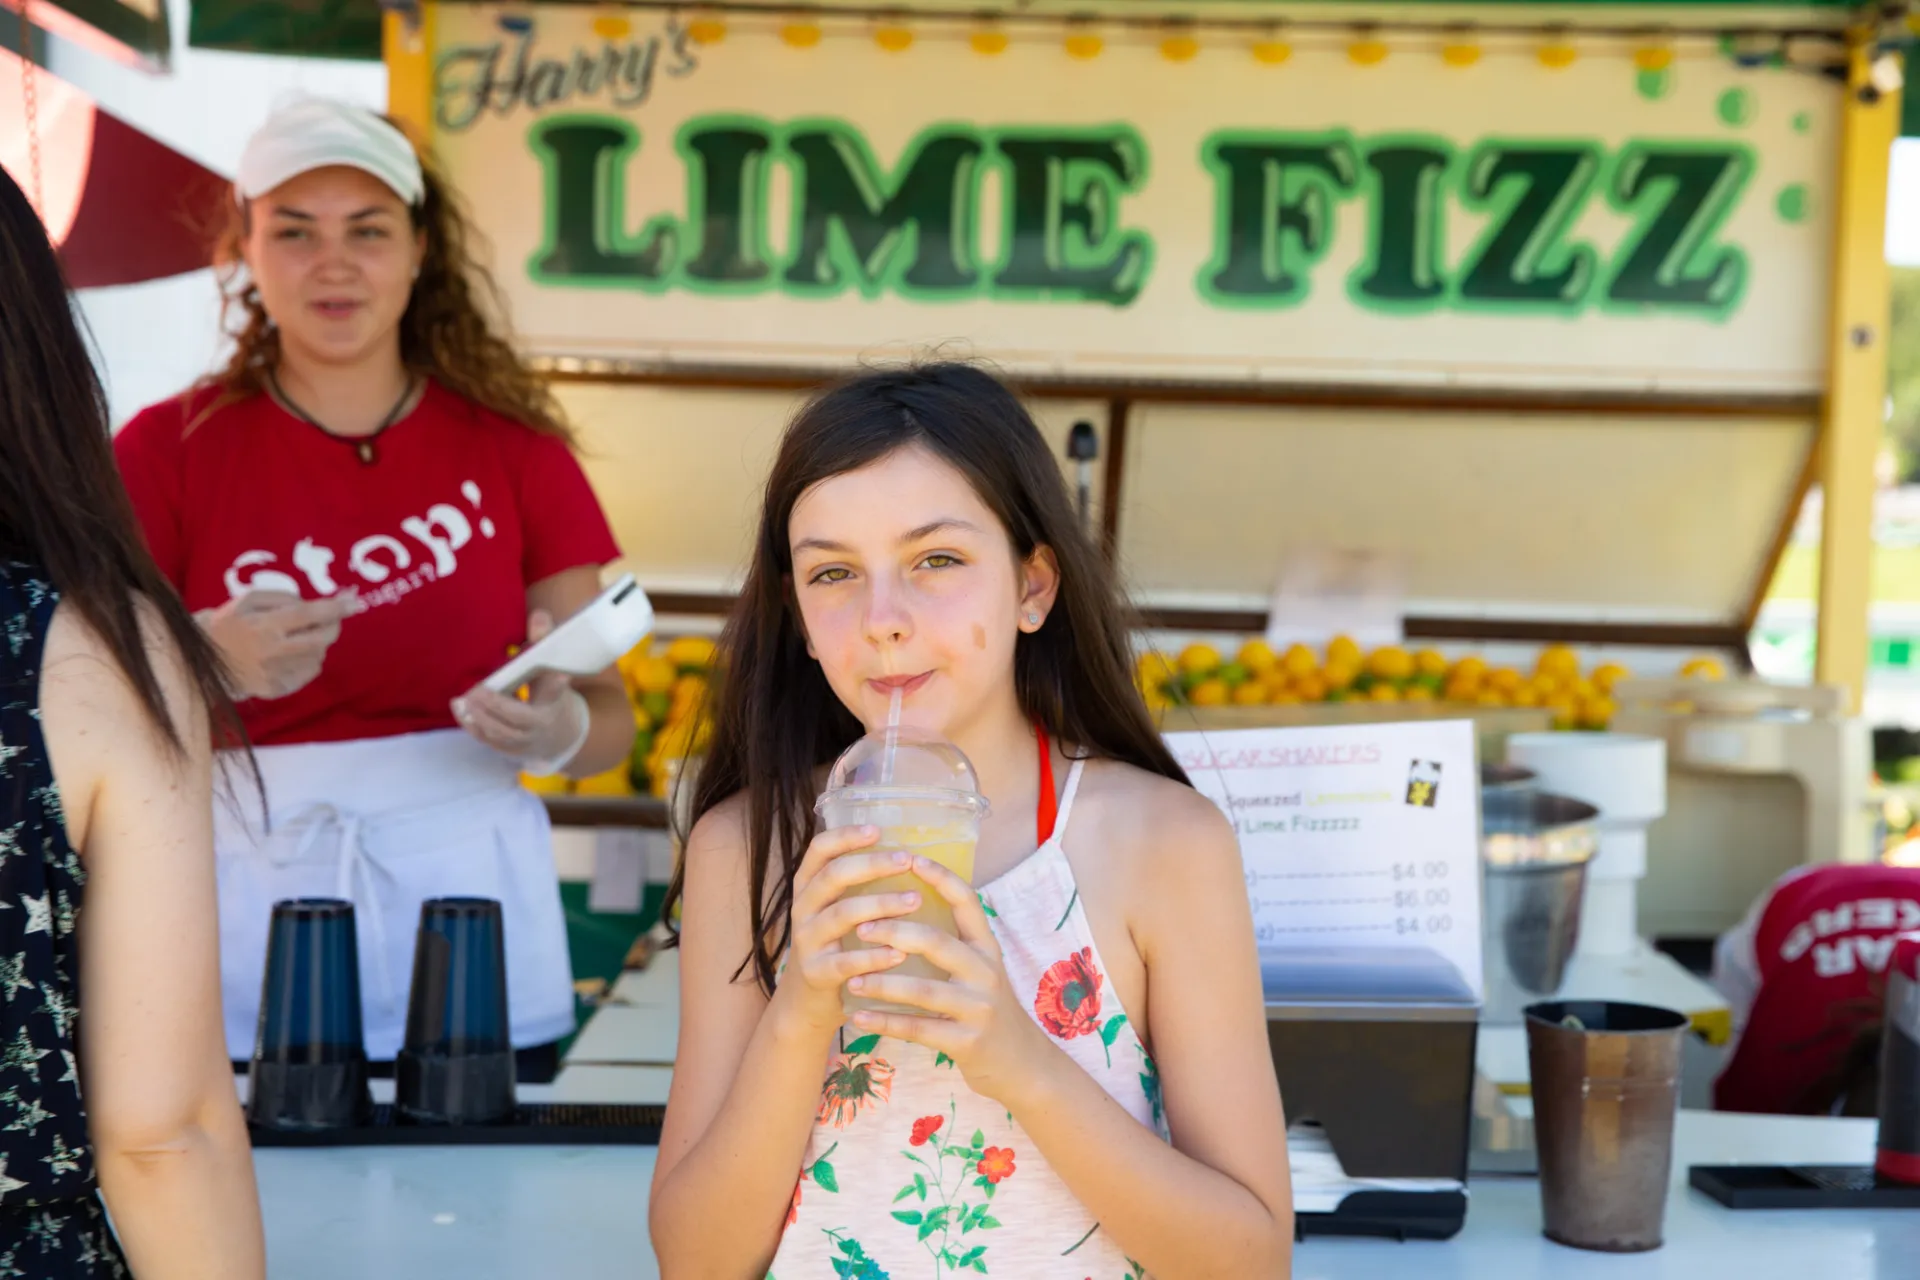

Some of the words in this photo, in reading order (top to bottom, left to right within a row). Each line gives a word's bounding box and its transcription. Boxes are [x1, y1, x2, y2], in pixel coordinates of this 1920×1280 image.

[434, 14, 698, 132] Harry's
[527, 111, 1154, 308] LIME
[1195, 126, 1759, 325] FIZZ
[1244, 817, 1287, 835] Lime
[1392, 861, 1449, 881] $4.00
